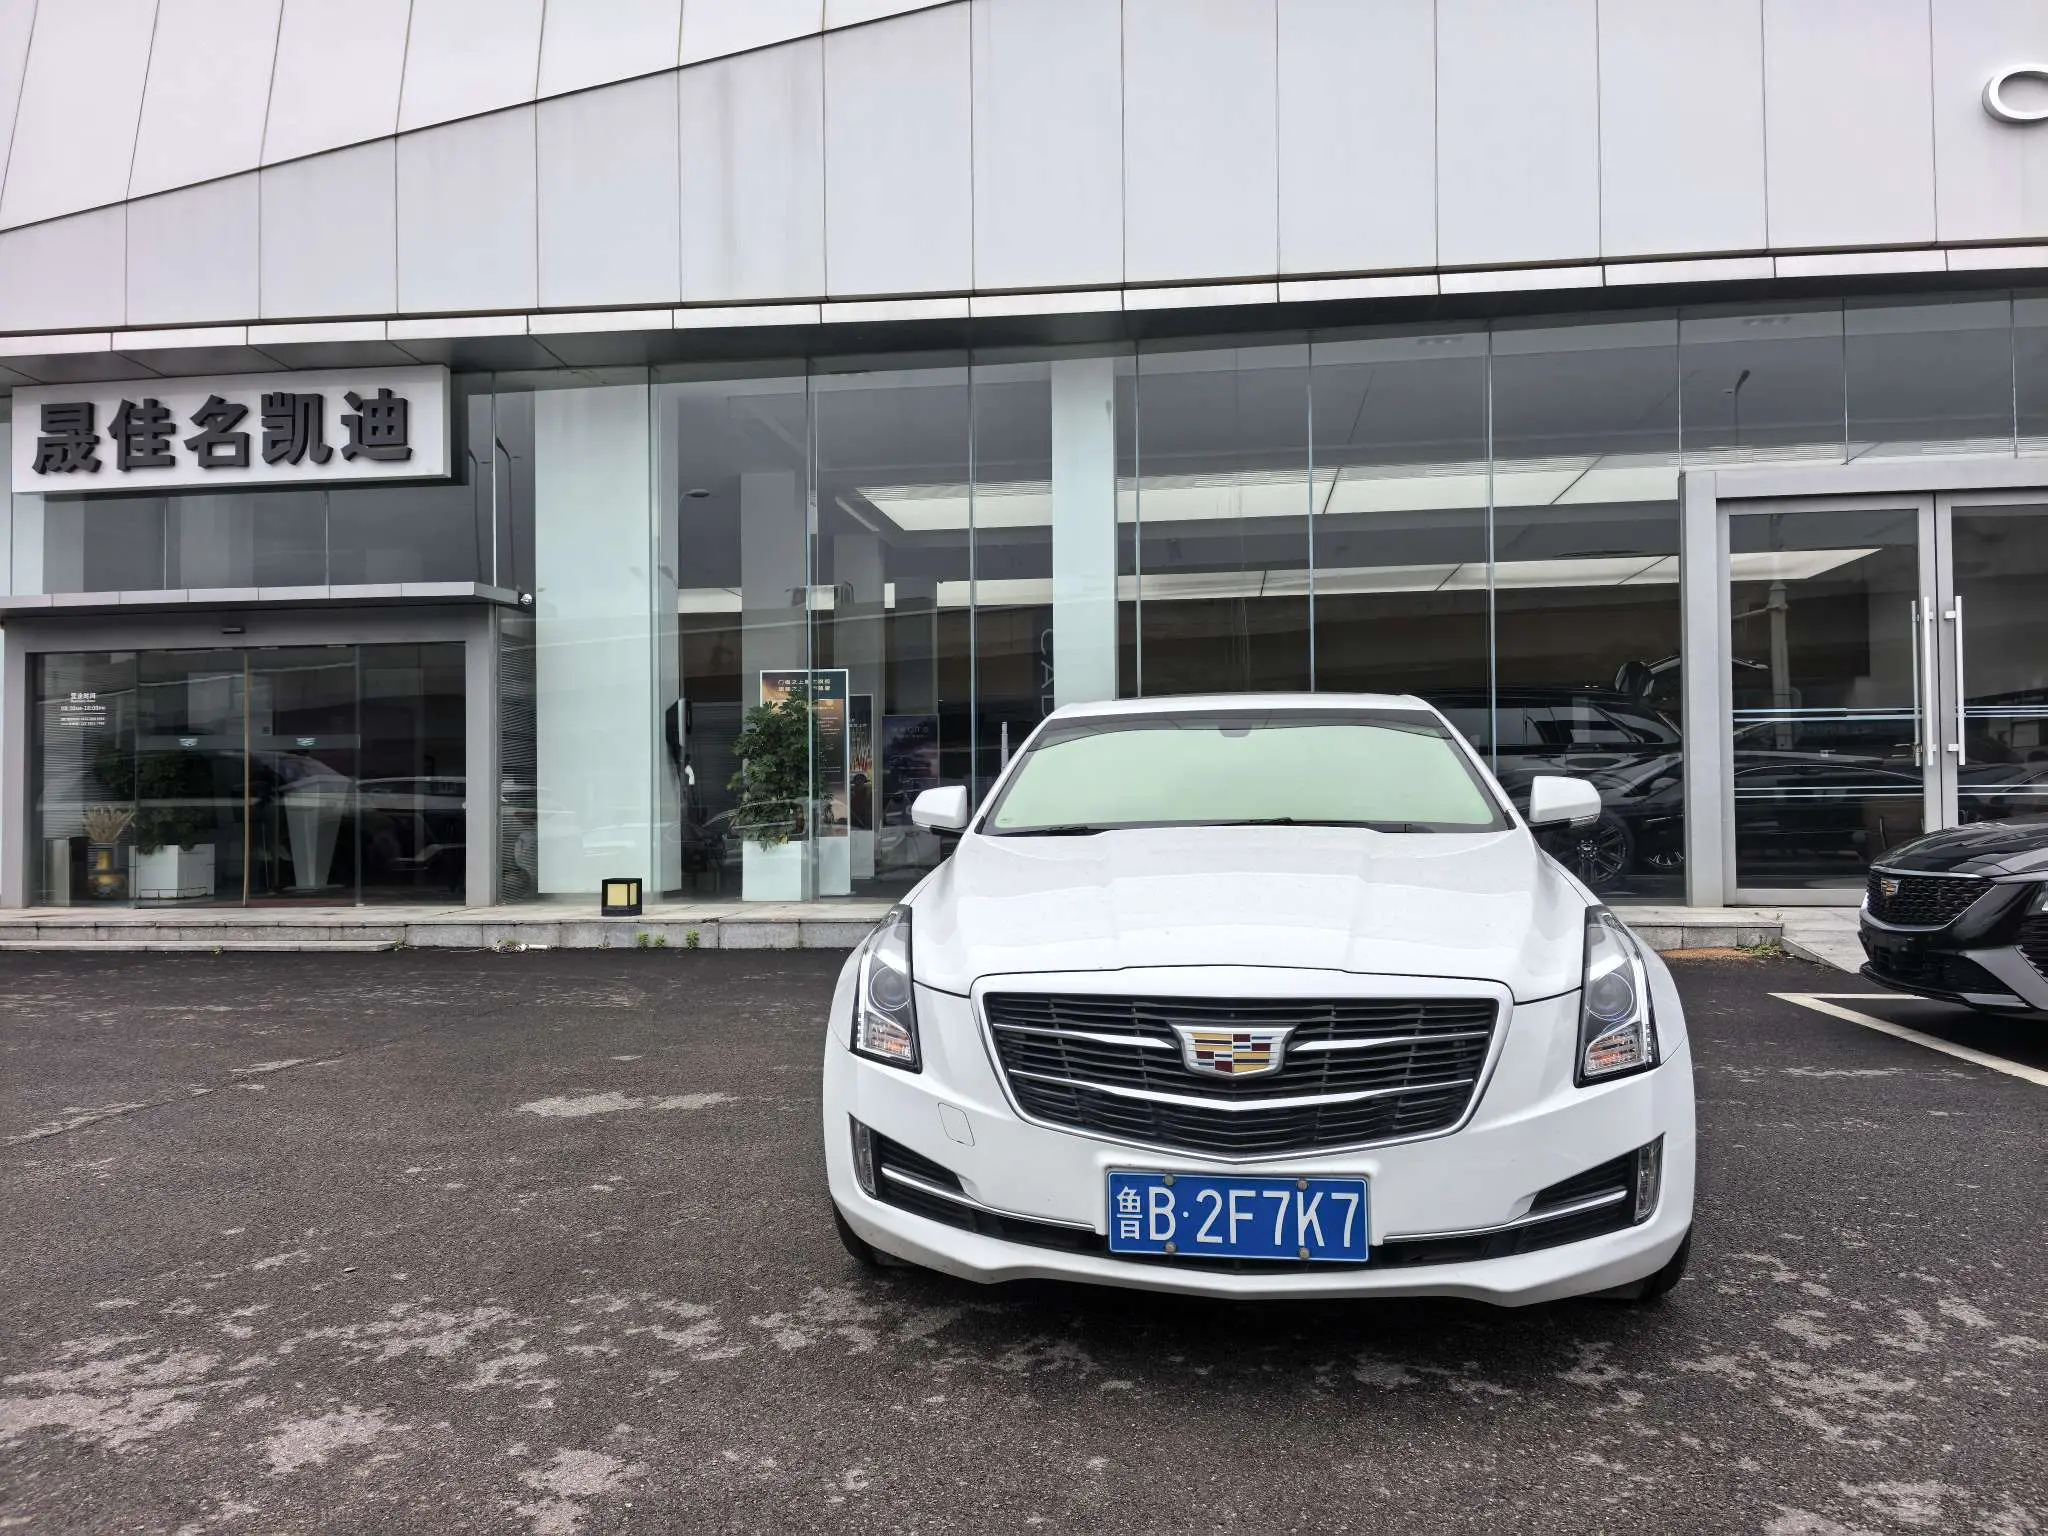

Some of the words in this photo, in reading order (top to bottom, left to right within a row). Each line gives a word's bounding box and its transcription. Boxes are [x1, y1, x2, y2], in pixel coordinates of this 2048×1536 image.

[32, 388, 413, 475] 晟佳名凯迪
